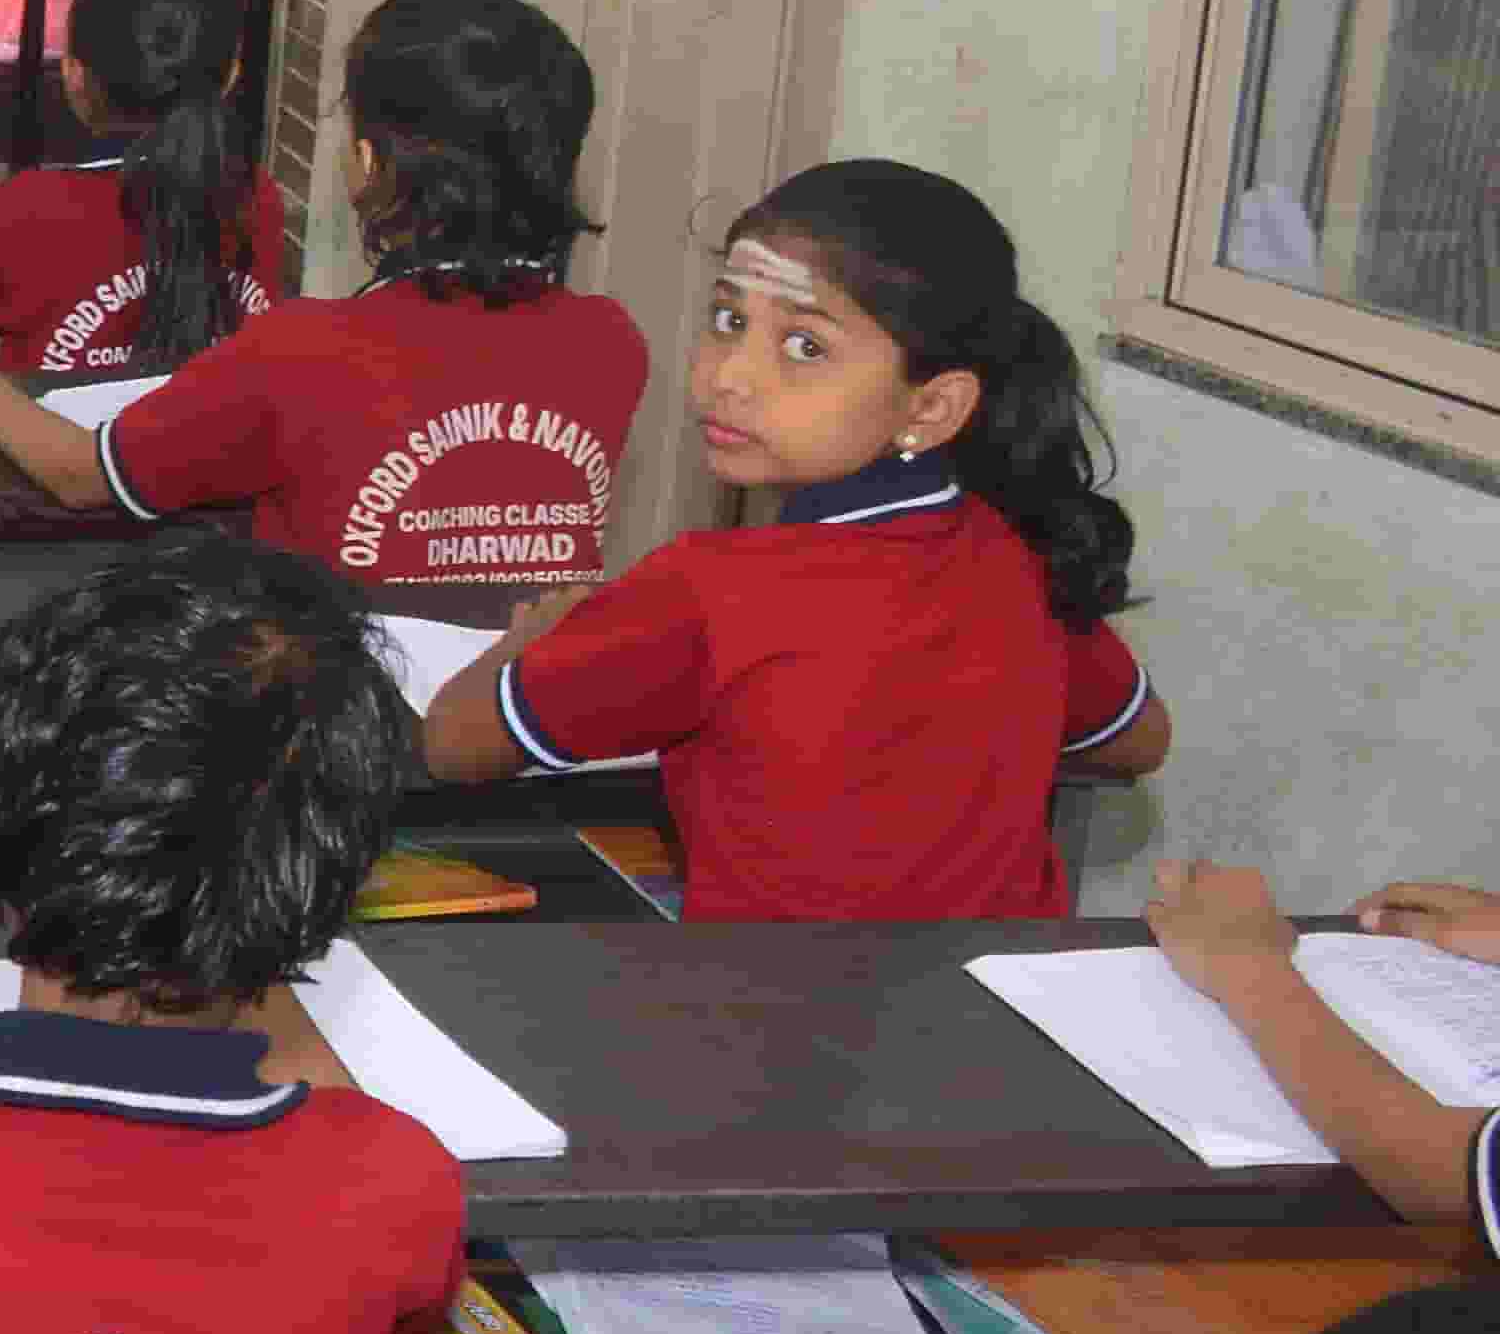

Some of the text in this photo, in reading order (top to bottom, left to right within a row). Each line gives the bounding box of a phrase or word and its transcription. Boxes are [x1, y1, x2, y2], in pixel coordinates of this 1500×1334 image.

[340, 450, 419, 566] OXFORD
[408, 403, 504, 466] SAINIK
[508, 403, 530, 442] &
[428, 533, 575, 566] DHARWAD
